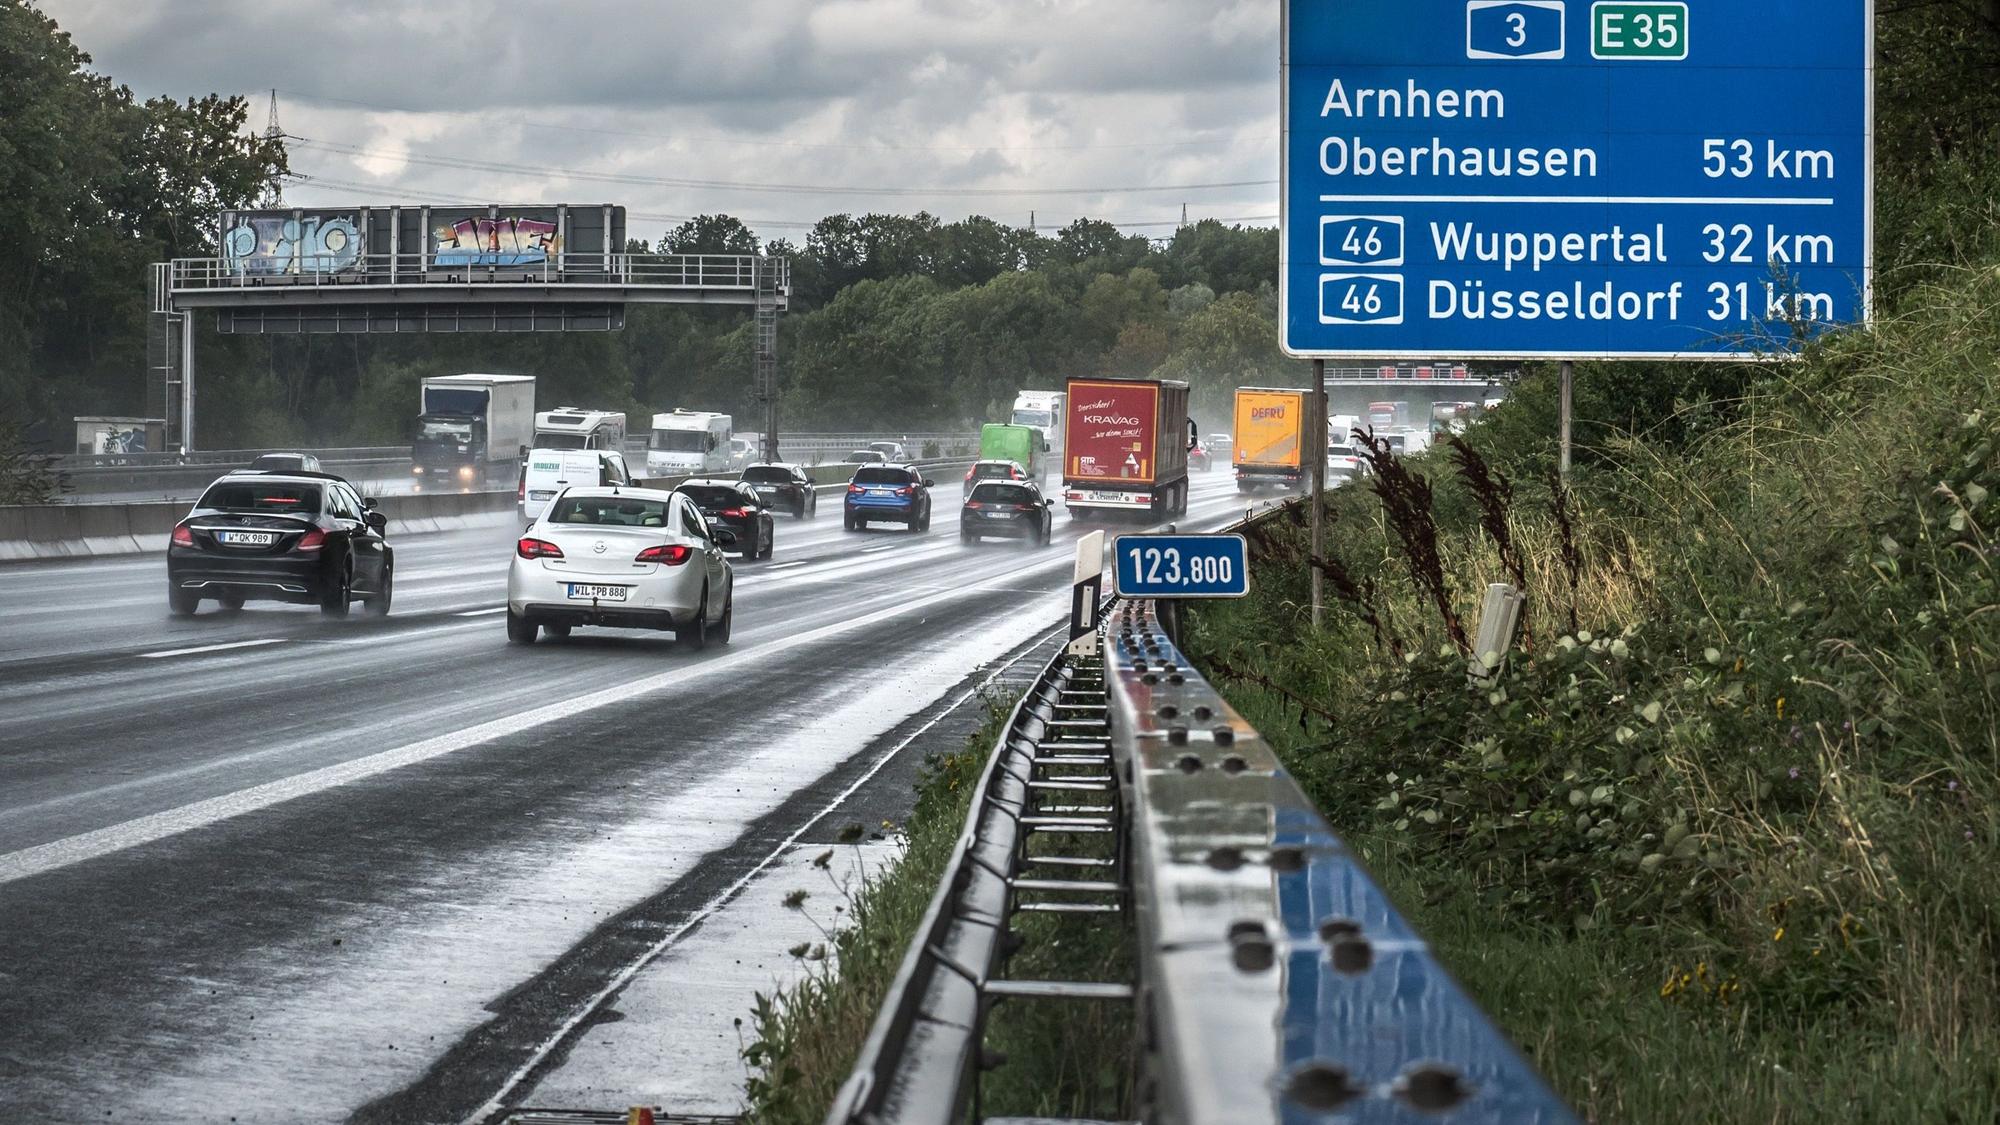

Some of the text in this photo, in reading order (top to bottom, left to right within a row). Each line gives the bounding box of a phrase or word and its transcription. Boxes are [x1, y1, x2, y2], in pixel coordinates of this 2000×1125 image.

[1505, 12, 1526, 47] 3
[1601, 13, 1678, 48] E 35
[1320, 79, 1504, 118] Arnhem
[1319, 136, 1834, 178] Oberhausen 53 km
[1341, 222, 1834, 271] 46 Wuppertal 32 km
[1341, 280, 1833, 321] 46 Düsseldorf 31 km
[1084, 415, 1139, 425] KRAVAG
[252, 534, 269, 543] 989
[1129, 548, 1232, 586] 123,800
[574, 586, 625, 598] WIL PB 888
